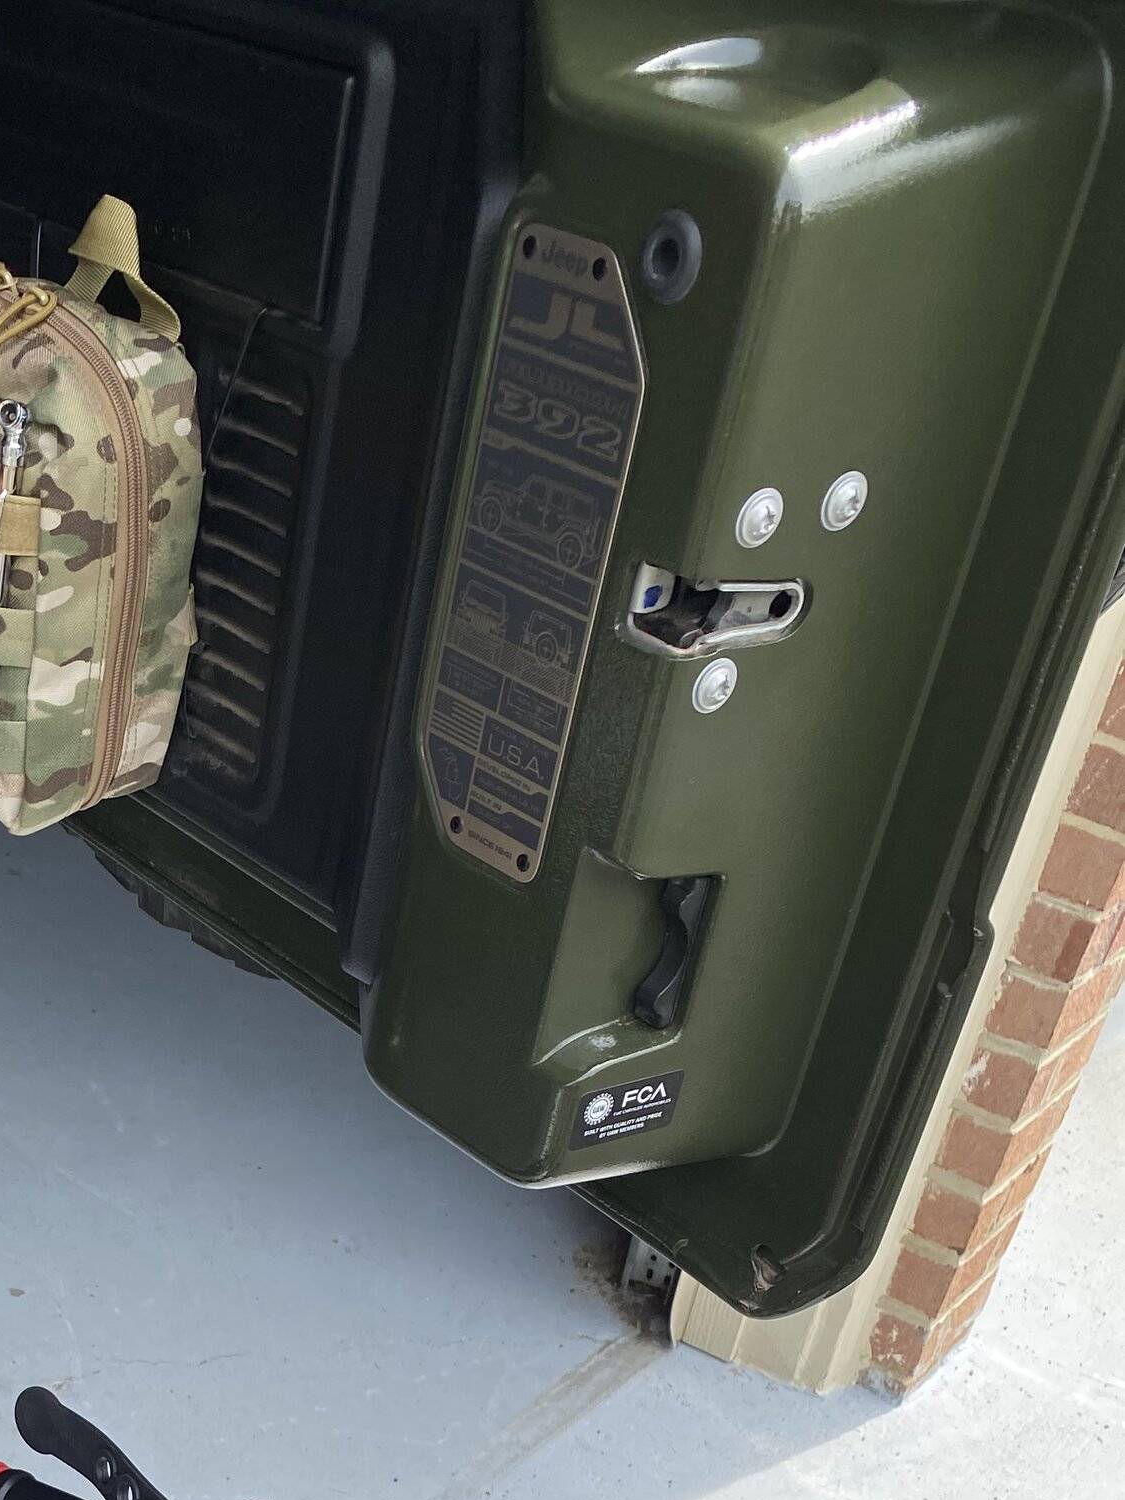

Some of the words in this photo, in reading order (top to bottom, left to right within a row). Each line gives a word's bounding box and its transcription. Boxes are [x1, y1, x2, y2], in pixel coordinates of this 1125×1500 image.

[540, 241, 589, 278] Jeep
[509, 293, 628, 346] JL
[492, 381, 622, 463] 392
[488, 732, 545, 781] U.S.A.
[468, 829, 495, 850] SINCE
[622, 1082, 666, 1107] FCA
[584, 1127, 599, 1137] BUILT
[599, 1124, 613, 1133] WITH
[613, 1118, 635, 1129] QUALITY
[635, 1115, 647, 1124] AND
[646, 1111, 663, 1121] PRIDE
